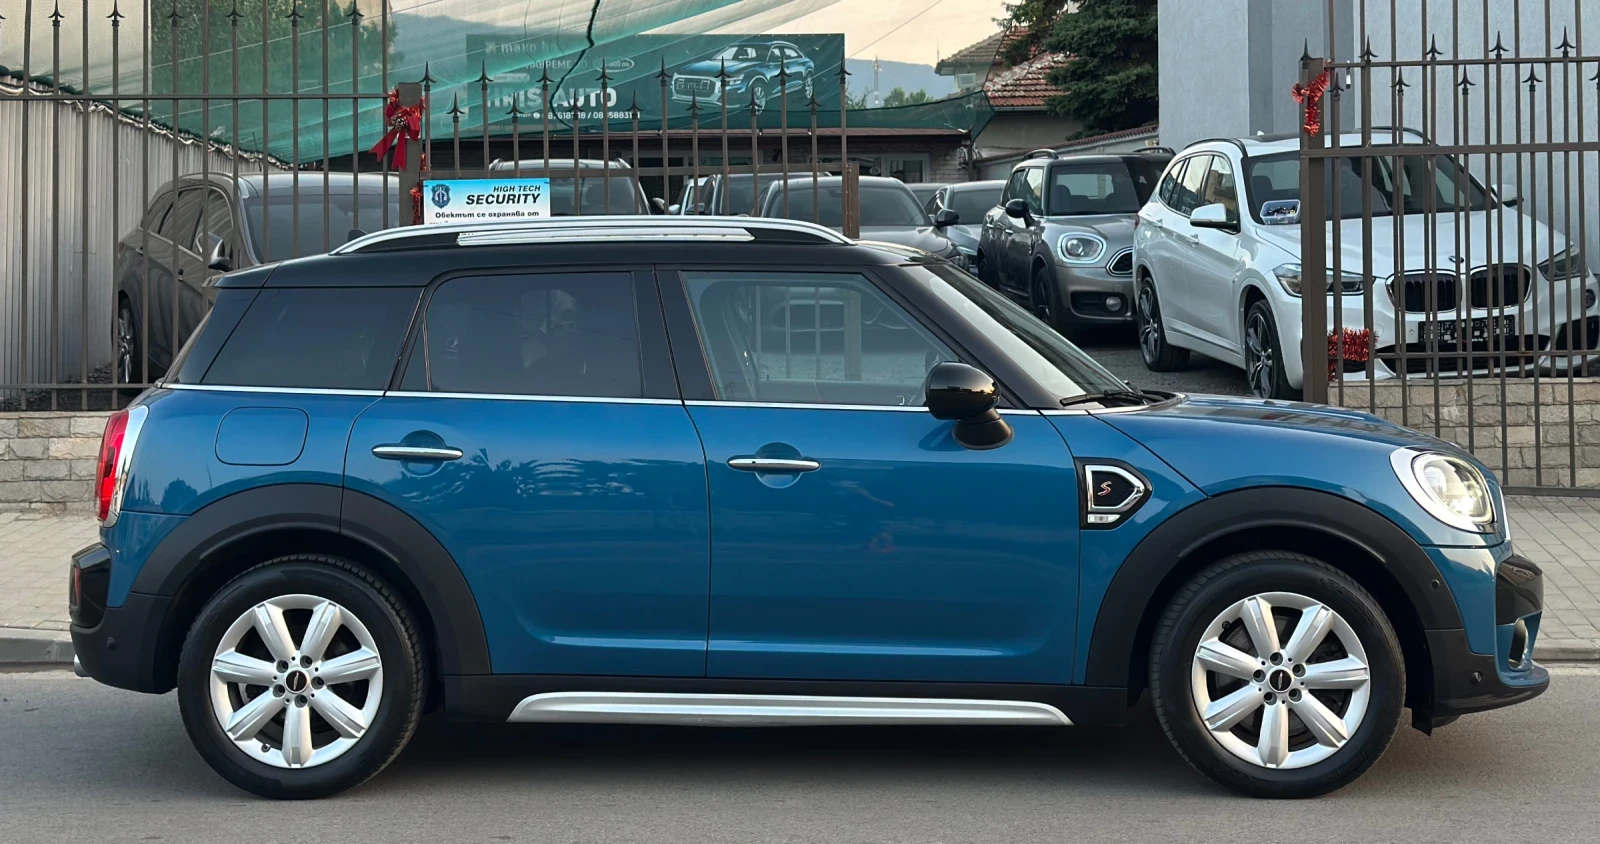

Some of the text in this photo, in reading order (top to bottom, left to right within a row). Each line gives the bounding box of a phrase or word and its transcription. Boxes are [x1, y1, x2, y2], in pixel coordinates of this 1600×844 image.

[552, 87, 617, 108] AUTO
[465, 193, 541, 206] SECURITY
[435, 211, 475, 219] Обектът
[488, 210, 525, 220] охранява
[1097, 480, 1112, 497] S
